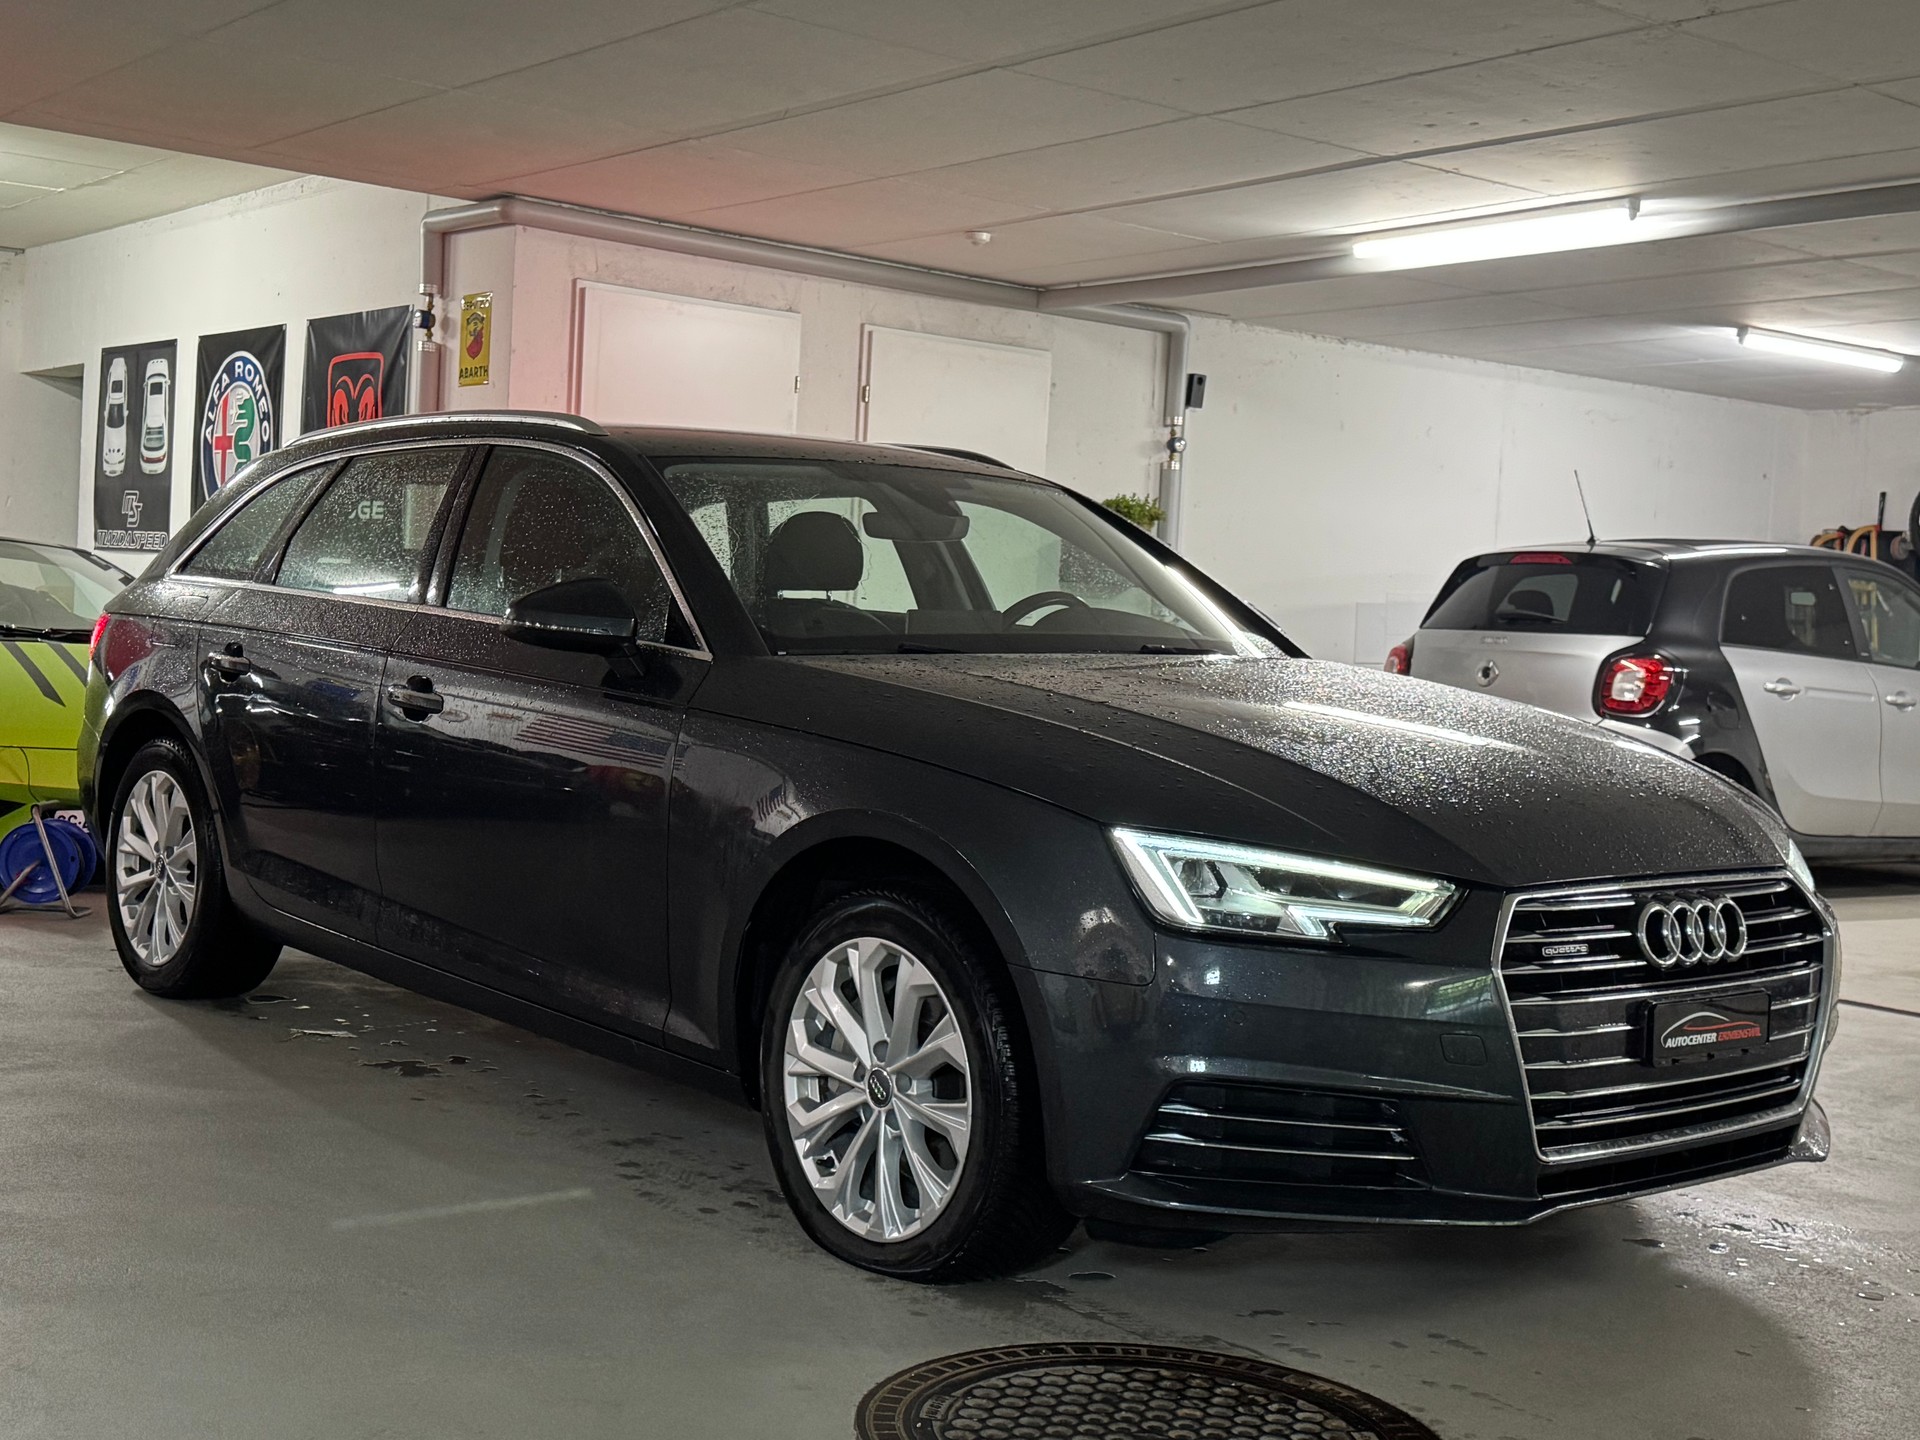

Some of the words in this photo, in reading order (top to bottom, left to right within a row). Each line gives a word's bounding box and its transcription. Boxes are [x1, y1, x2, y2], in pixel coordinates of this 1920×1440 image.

[459, 366, 489, 379] ABARTH
[205, 372, 230, 444] ALFA
[235, 361, 270, 442] ROMEO
[97, 529, 168, 549] MAZDASPEED
[1545, 946, 1587, 955] quattro
[1665, 1033, 1717, 1048] AUTOCENTER
